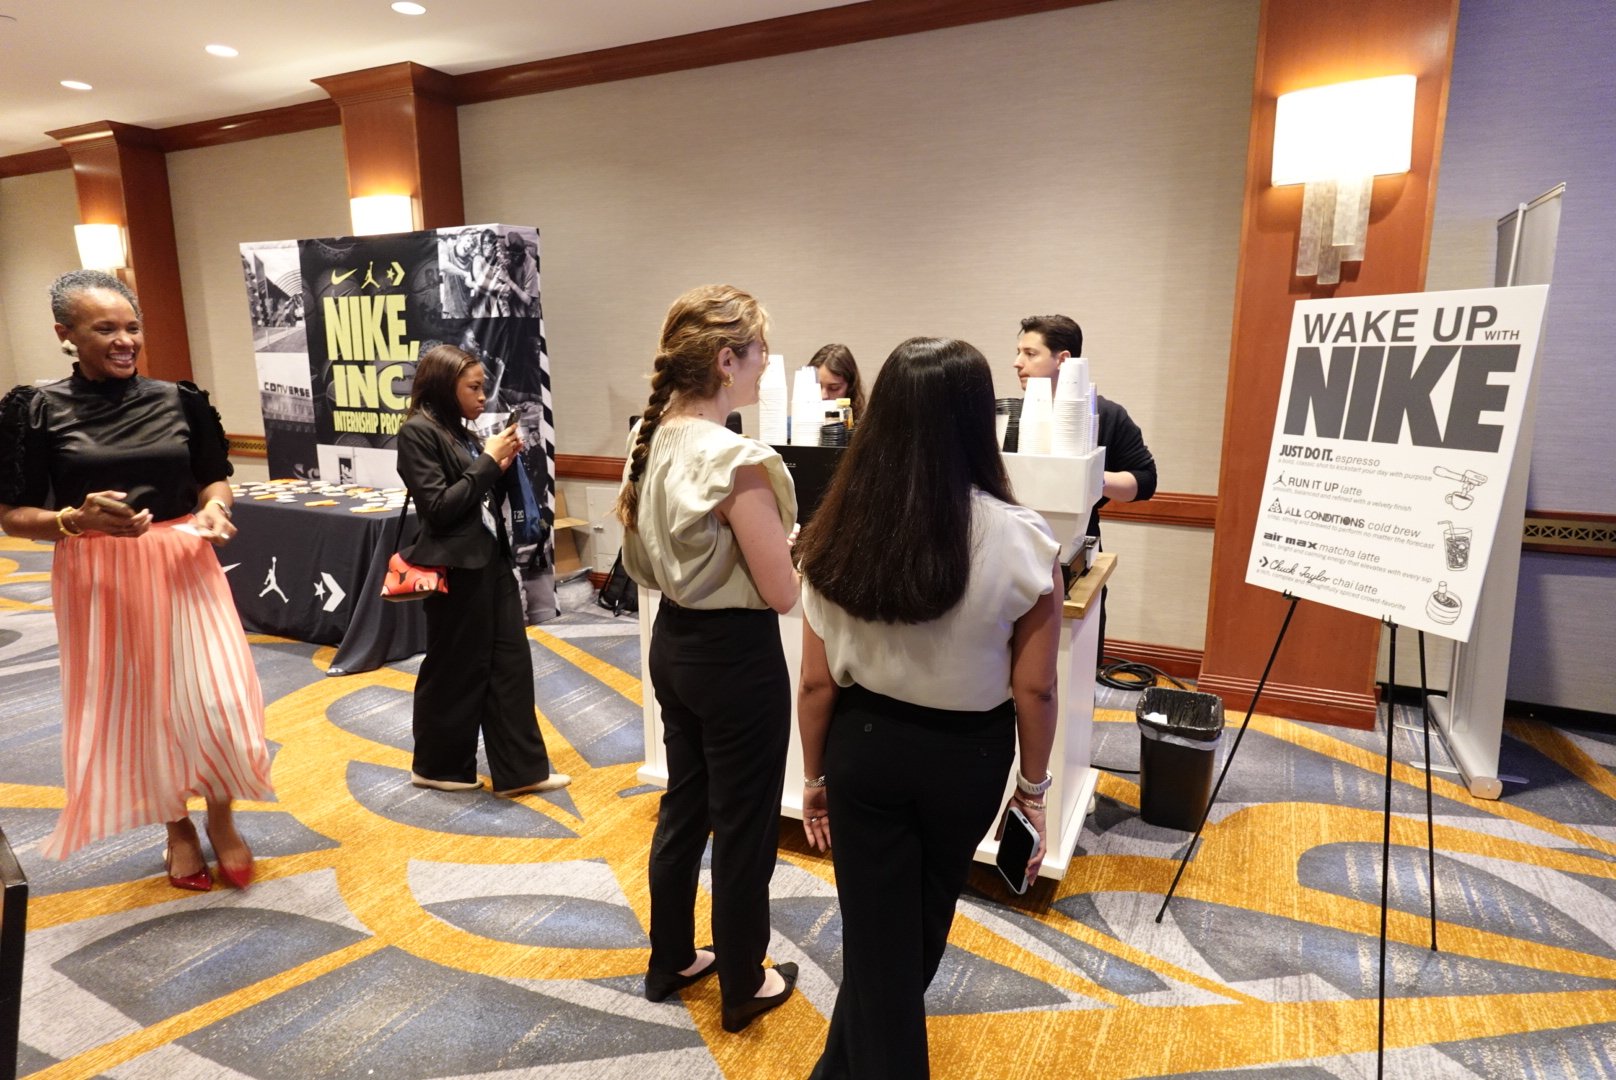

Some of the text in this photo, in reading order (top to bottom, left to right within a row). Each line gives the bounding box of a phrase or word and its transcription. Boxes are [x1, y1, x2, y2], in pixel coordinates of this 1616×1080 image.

[1303, 305, 1520, 343] WAKE UP WITH
[264, 381, 311, 398] CONVERSE
[1283, 344, 1521, 453] NIKE
[333, 410, 379, 434] INTERNSHIP
[1280, 444, 1381, 467] JUST DO IT. espresso
[1288, 477, 1363, 496] RUN IT UP latte
[1285, 507, 1421, 538] ALL CONDITIONS cold brew
[1264, 532, 1381, 563] air max matcha latte
[1270, 560, 1378, 595] Chuck Taylor chai latte
